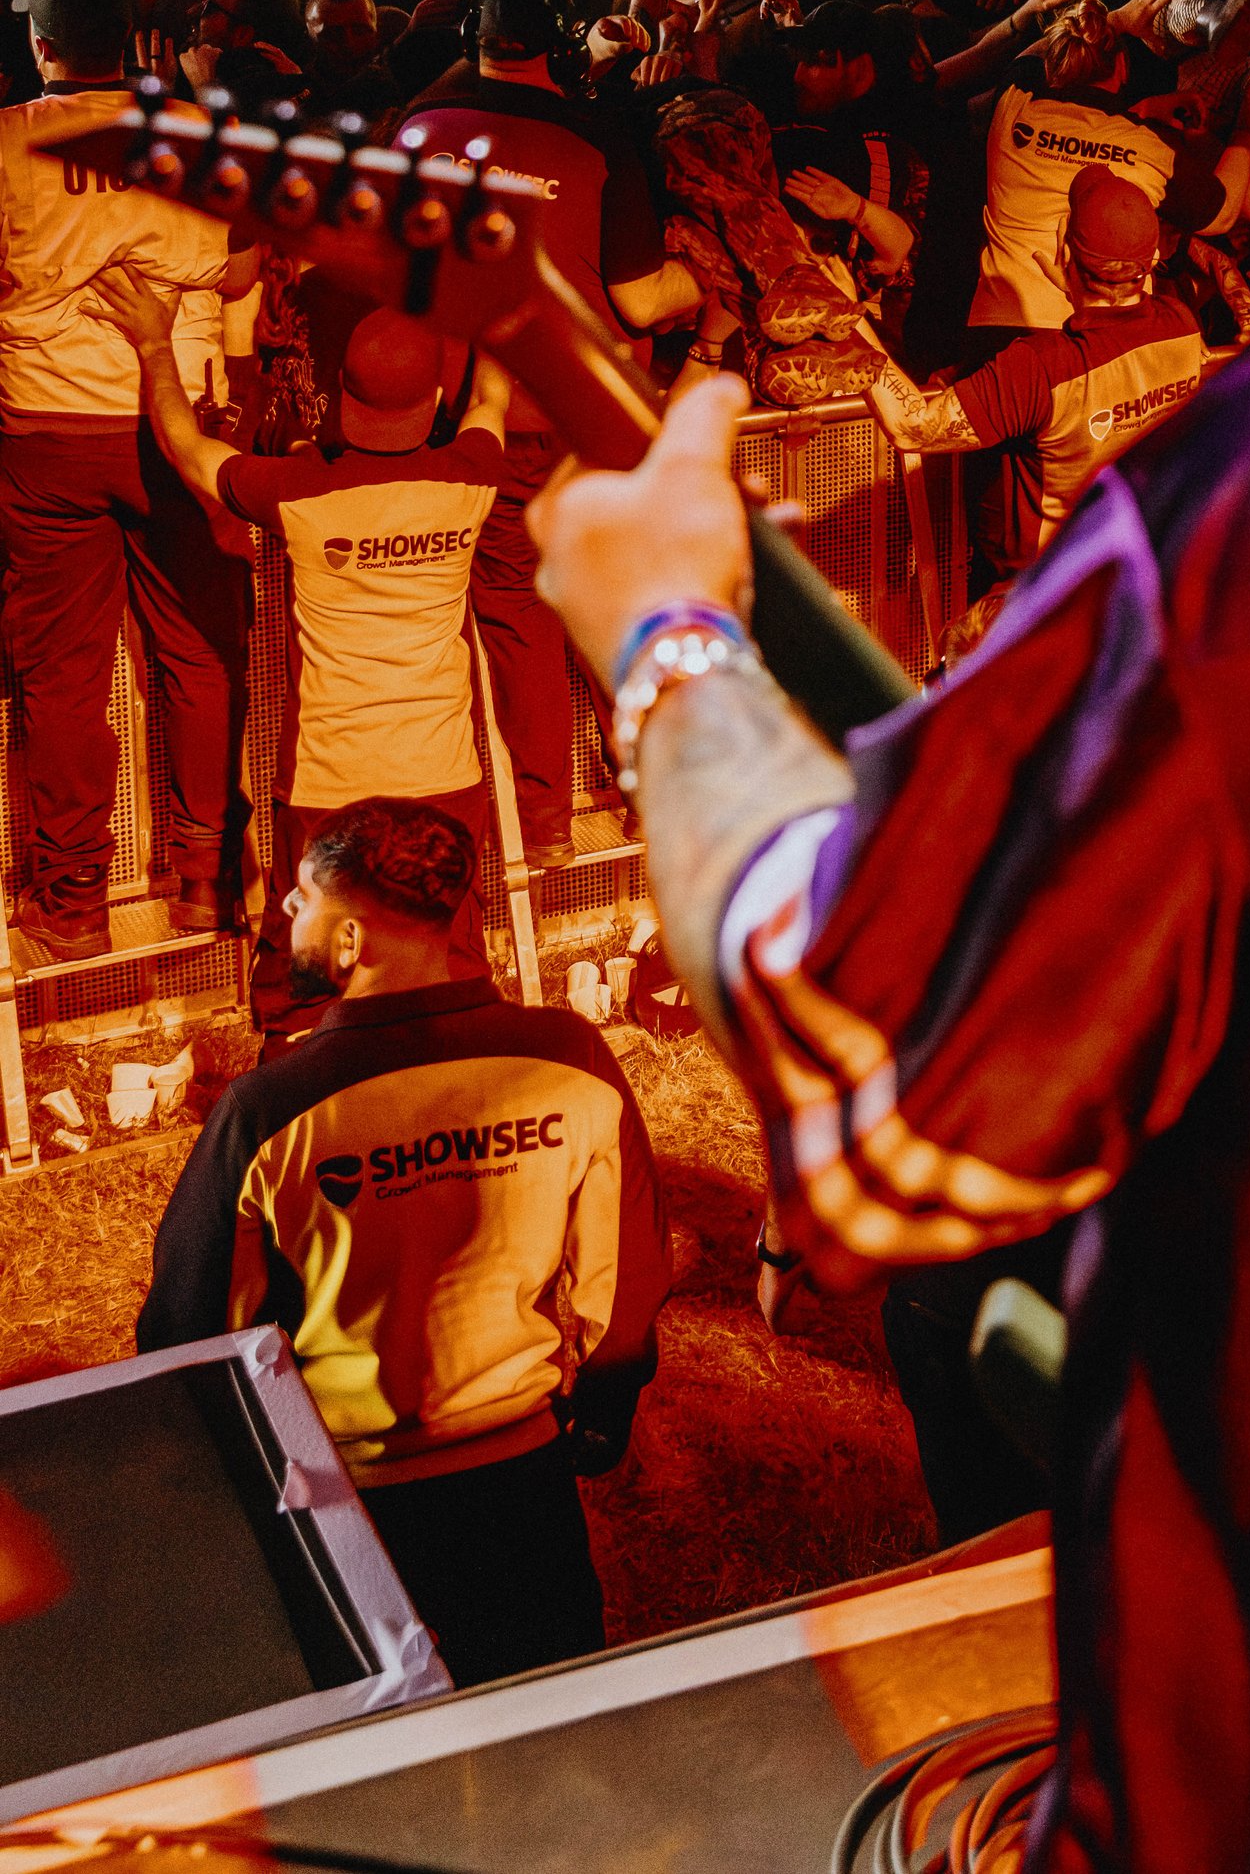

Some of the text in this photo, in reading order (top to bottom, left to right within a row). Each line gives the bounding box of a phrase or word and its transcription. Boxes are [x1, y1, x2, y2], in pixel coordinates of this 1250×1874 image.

[1034, 148, 1060, 162] Crowd
[1035, 130, 1138, 167] SHOWSEC
[1112, 375, 1198, 424] SHOWSEC
[356, 554, 446, 570] Crowd Management
[357, 527, 473, 561] SHOWSEC
[369, 1112, 564, 1183] SHOWSEC
[375, 1161, 519, 1201] Crowd Management
